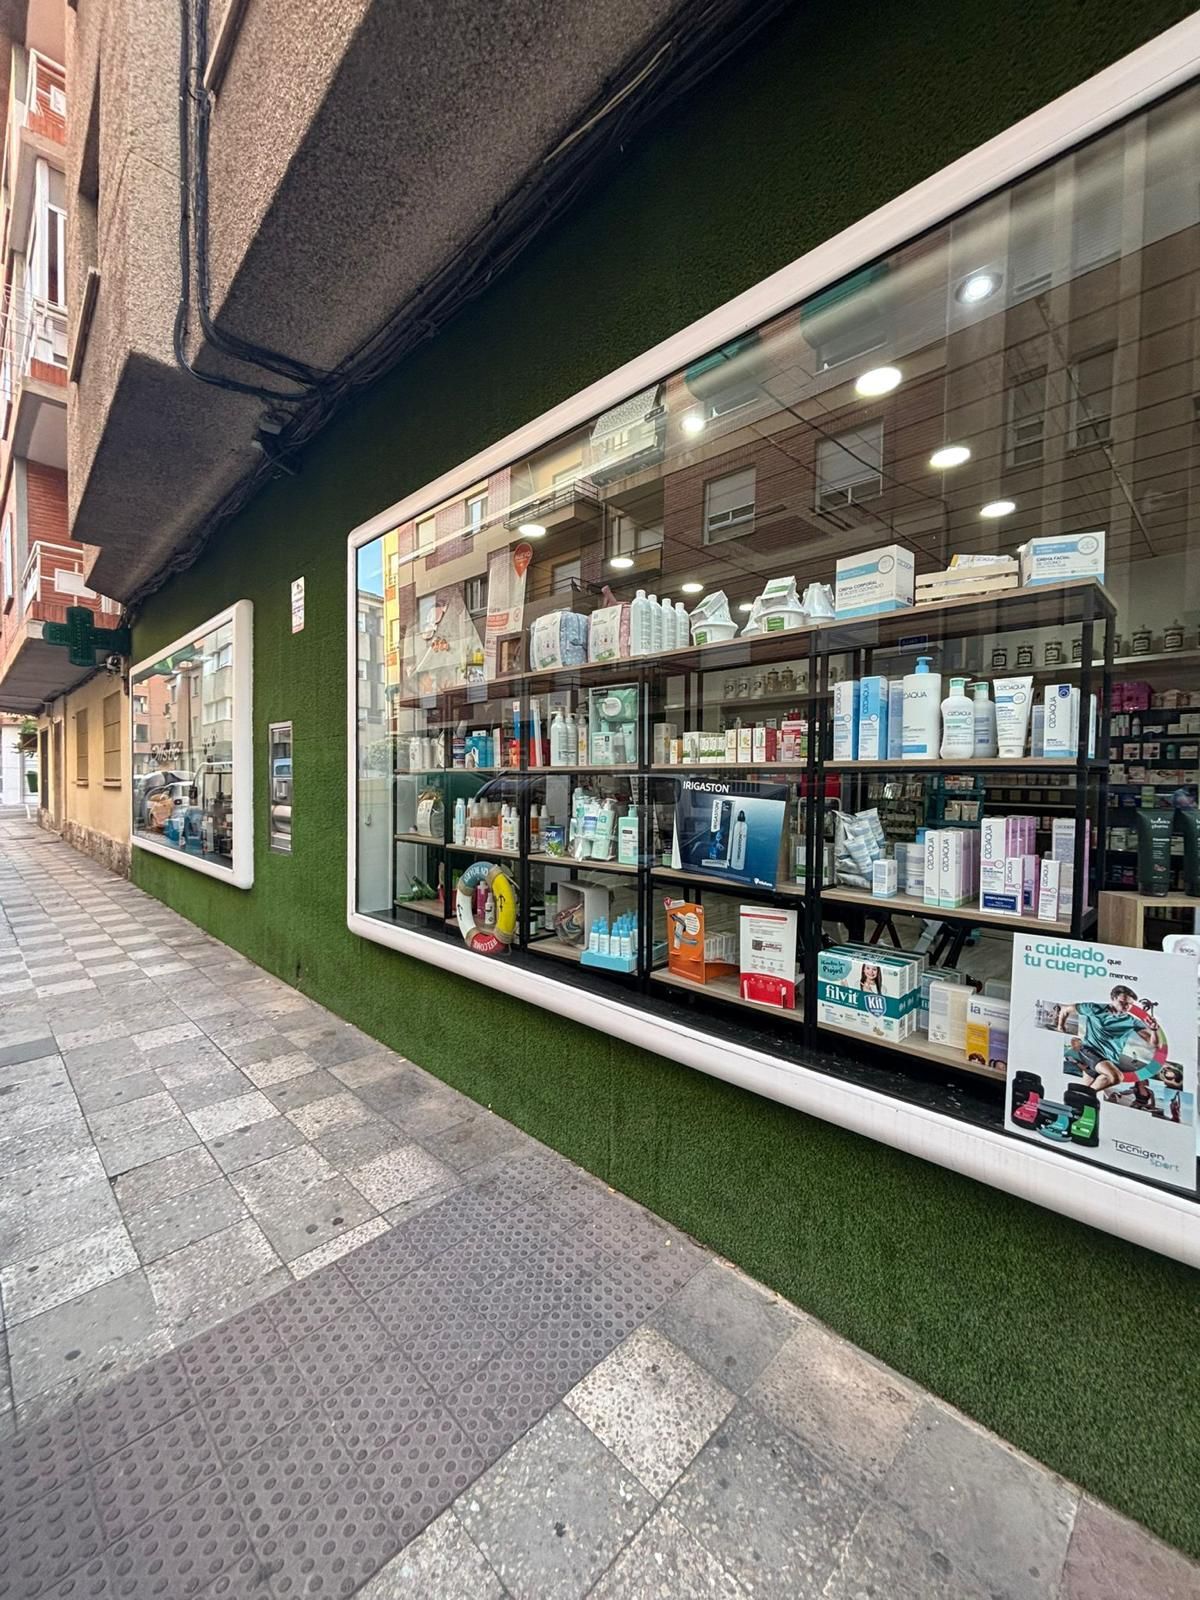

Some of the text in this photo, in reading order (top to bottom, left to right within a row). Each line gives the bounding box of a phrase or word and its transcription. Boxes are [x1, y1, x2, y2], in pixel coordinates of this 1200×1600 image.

[1048, 696, 1057, 728] OZOAQUA
[683, 781, 730, 793] IRIGASTON
[927, 837, 935, 870] OZOAQUA
[984, 824, 993, 859] OZOAQUA
[1036, 942, 1104, 962] cuidado
[1107, 958, 1122, 966] que
[1024, 953, 1138, 982] tu cuerpo merece
[825, 984, 859, 1005] filvit
[868, 996, 883, 1009] Kit
[1111, 1138, 1165, 1160] Tecnigen
